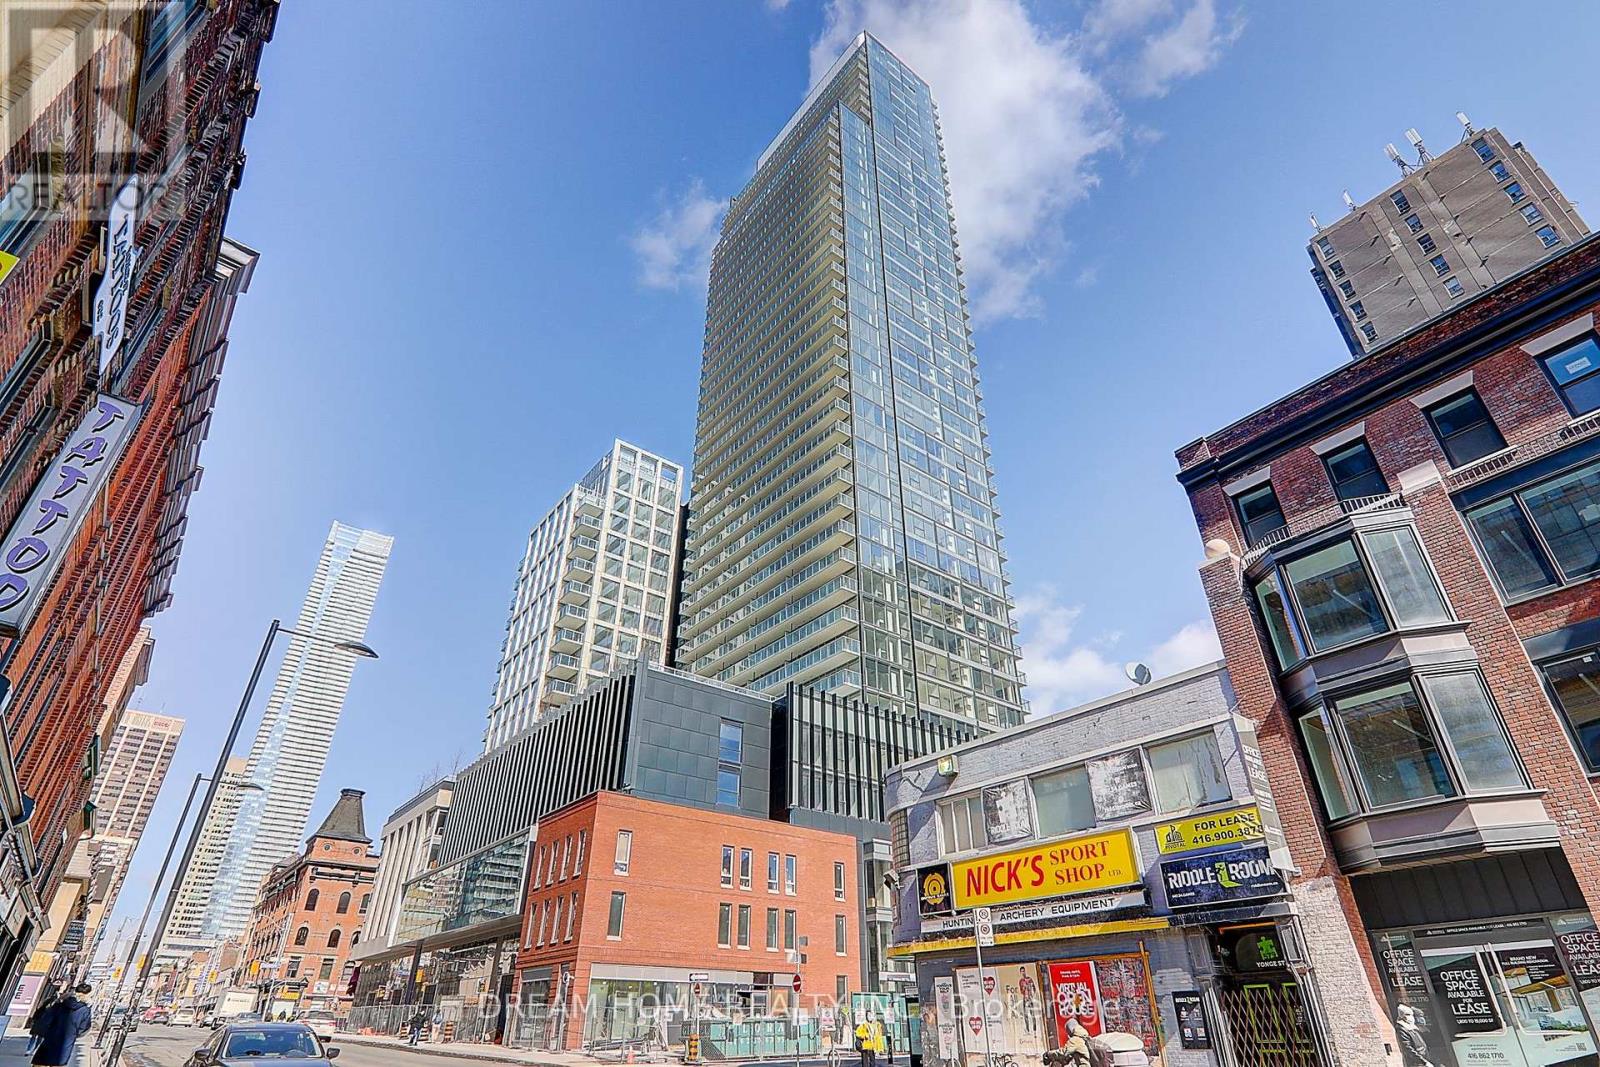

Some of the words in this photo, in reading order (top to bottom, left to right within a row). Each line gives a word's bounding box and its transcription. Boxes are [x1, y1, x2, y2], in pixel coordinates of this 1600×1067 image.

[0, 401, 124, 612] TATTOO
[1194, 820, 1217, 832] FOR
[1219, 812, 1256, 826] LEASE
[1165, 842, 1186, 850] PIVOTAL
[1050, 840, 1110, 866] SPORT
[966, 854, 1045, 897] NICK'S
[1054, 863, 1105, 886] SHOP
[1167, 866, 1217, 890] RIDDLE
[1228, 858, 1275, 881] ROOM
[942, 917, 974, 929] HUNTIN
[999, 907, 1045, 922] ARCHERY
[1051, 898, 1116, 915] EQUIPMENT
[1561, 932, 1598, 945] OFFICE
[1383, 948, 1415, 959] OFFICE
[1566, 942, 1600, 953] SPACE
[1569, 952, 1600, 960] AVAILABL
[1387, 958, 1415, 968] SPACE
[1573, 962, 1600, 975] LEAS
[1391, 976, 1424, 987] LEASE
[1440, 969, 1479, 981] OFFICE
[1056, 982, 1088, 993] VIRTUAL
[1445, 980, 1480, 991] SPACE
[1057, 989, 1093, 1005] OPN
[1448, 990, 1485, 998] AVAILABLE
[1059, 1001, 1096, 1016] HOUSE
[1451, 1002, 1491, 1015] LEASE
